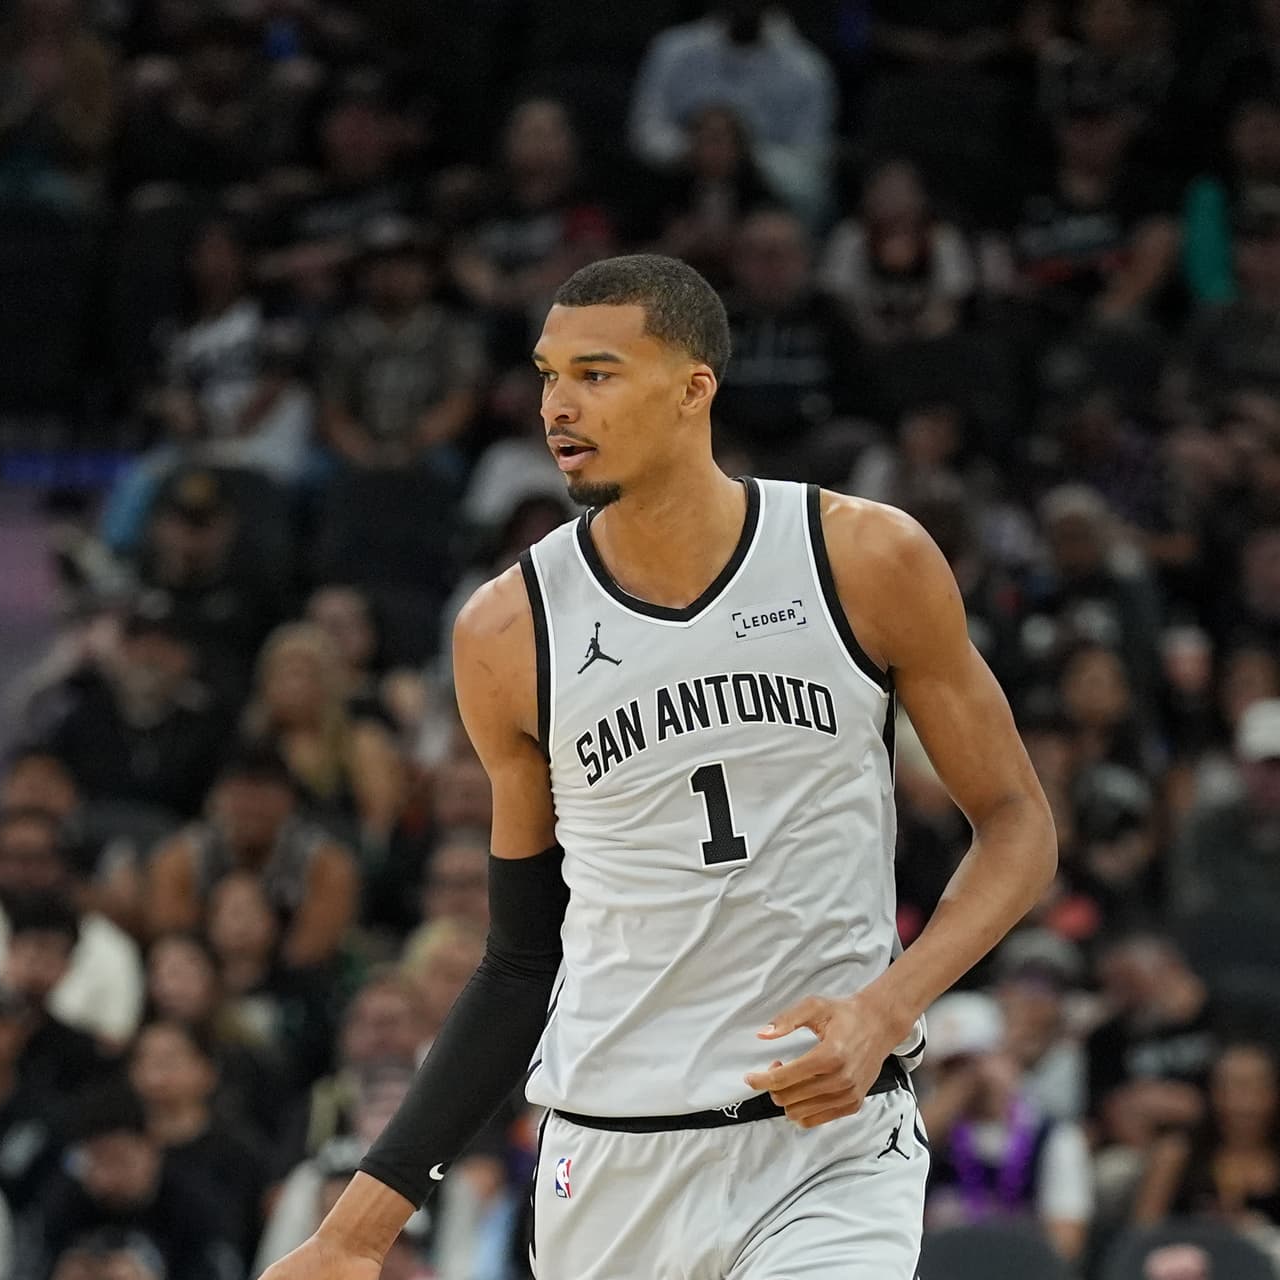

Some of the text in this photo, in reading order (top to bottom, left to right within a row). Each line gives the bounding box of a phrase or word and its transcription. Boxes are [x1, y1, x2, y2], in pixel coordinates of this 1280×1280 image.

[742, 608, 797, 630] LEDGER
[576, 671, 838, 787] SAN ANTONIO
[689, 762, 750, 866] 1
